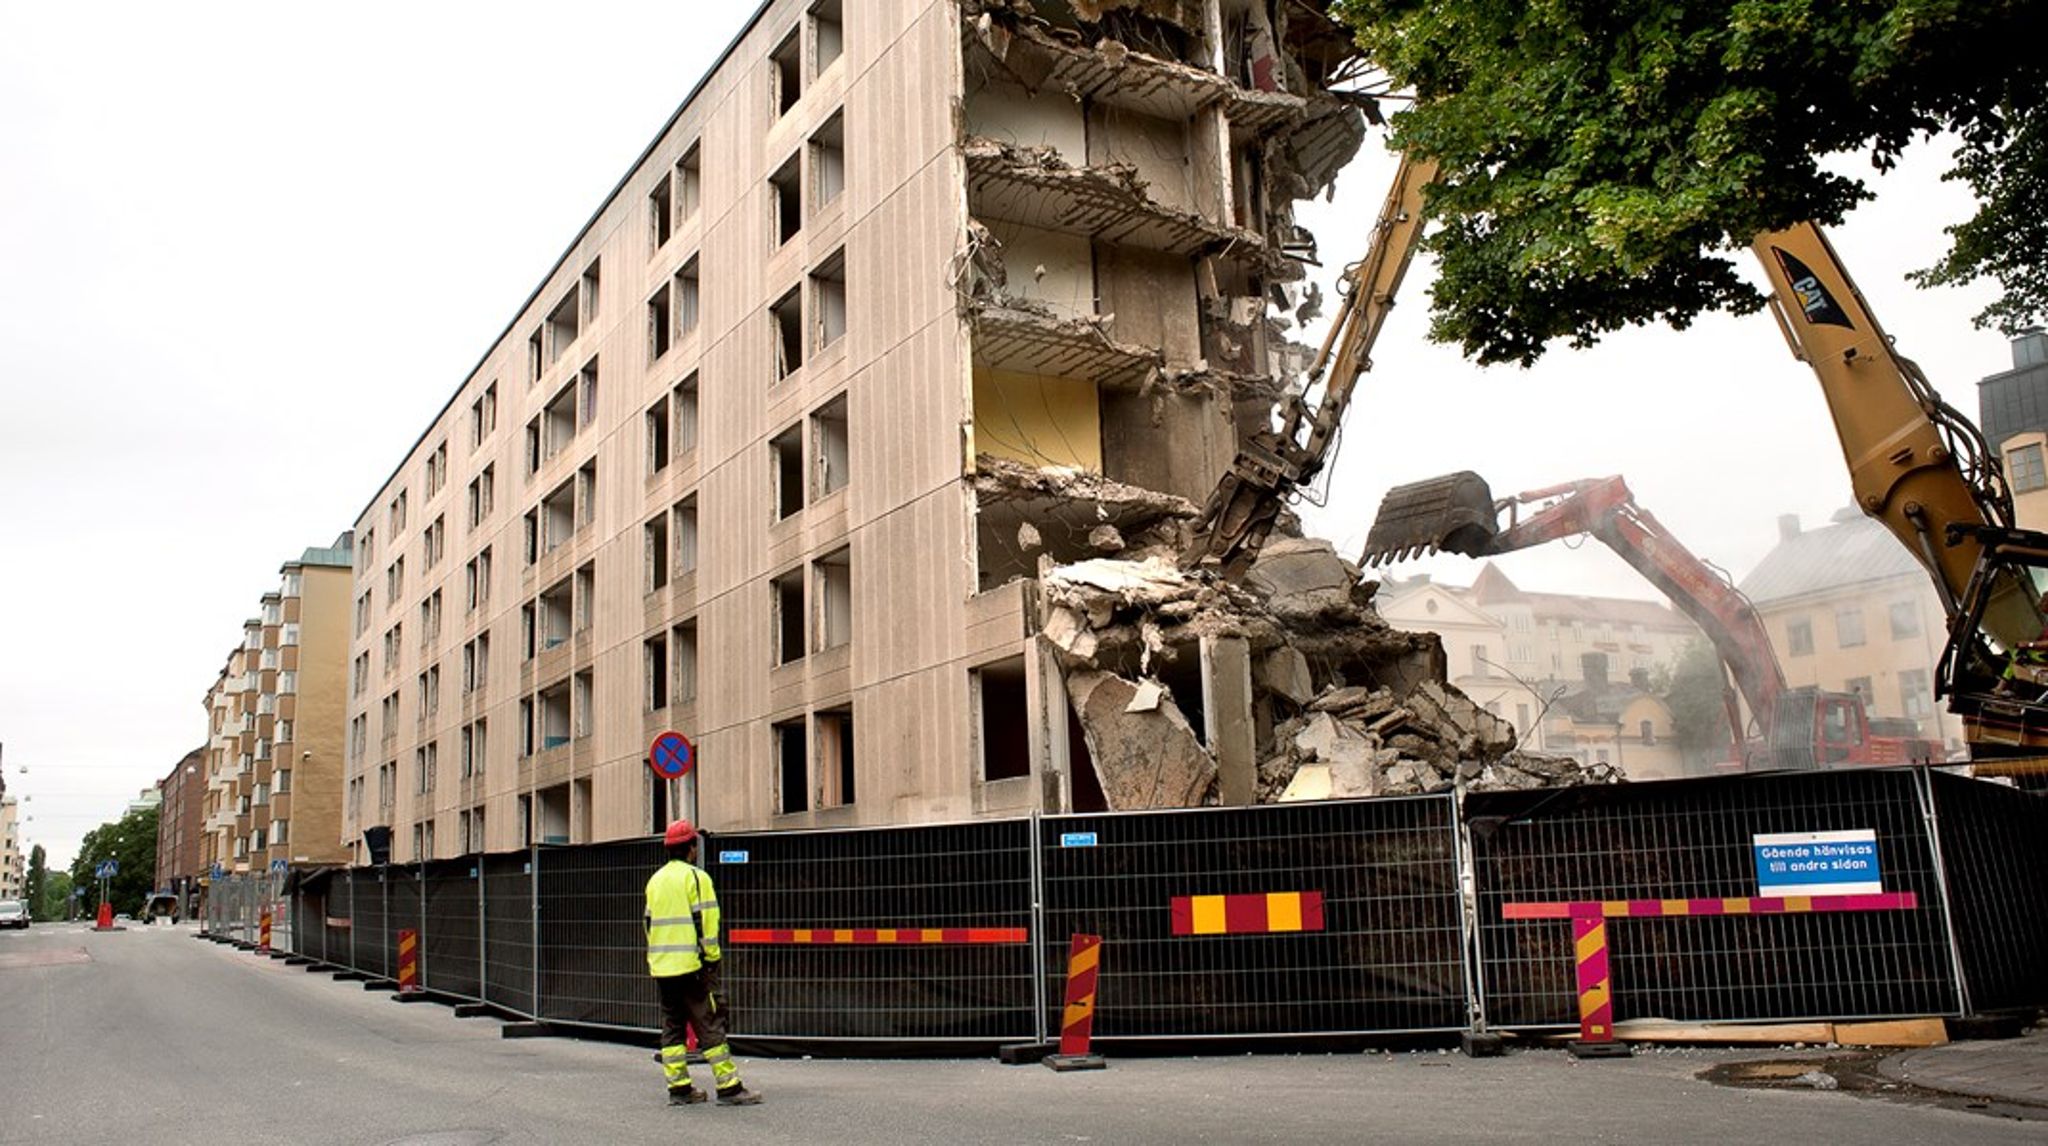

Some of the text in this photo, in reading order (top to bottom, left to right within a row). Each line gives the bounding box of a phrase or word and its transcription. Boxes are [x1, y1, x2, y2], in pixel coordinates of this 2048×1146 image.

[1793, 277, 1827, 312] CAT
[1762, 844, 1872, 858] Gående hänvisas
[1770, 858, 1867, 872] till andra sidan
